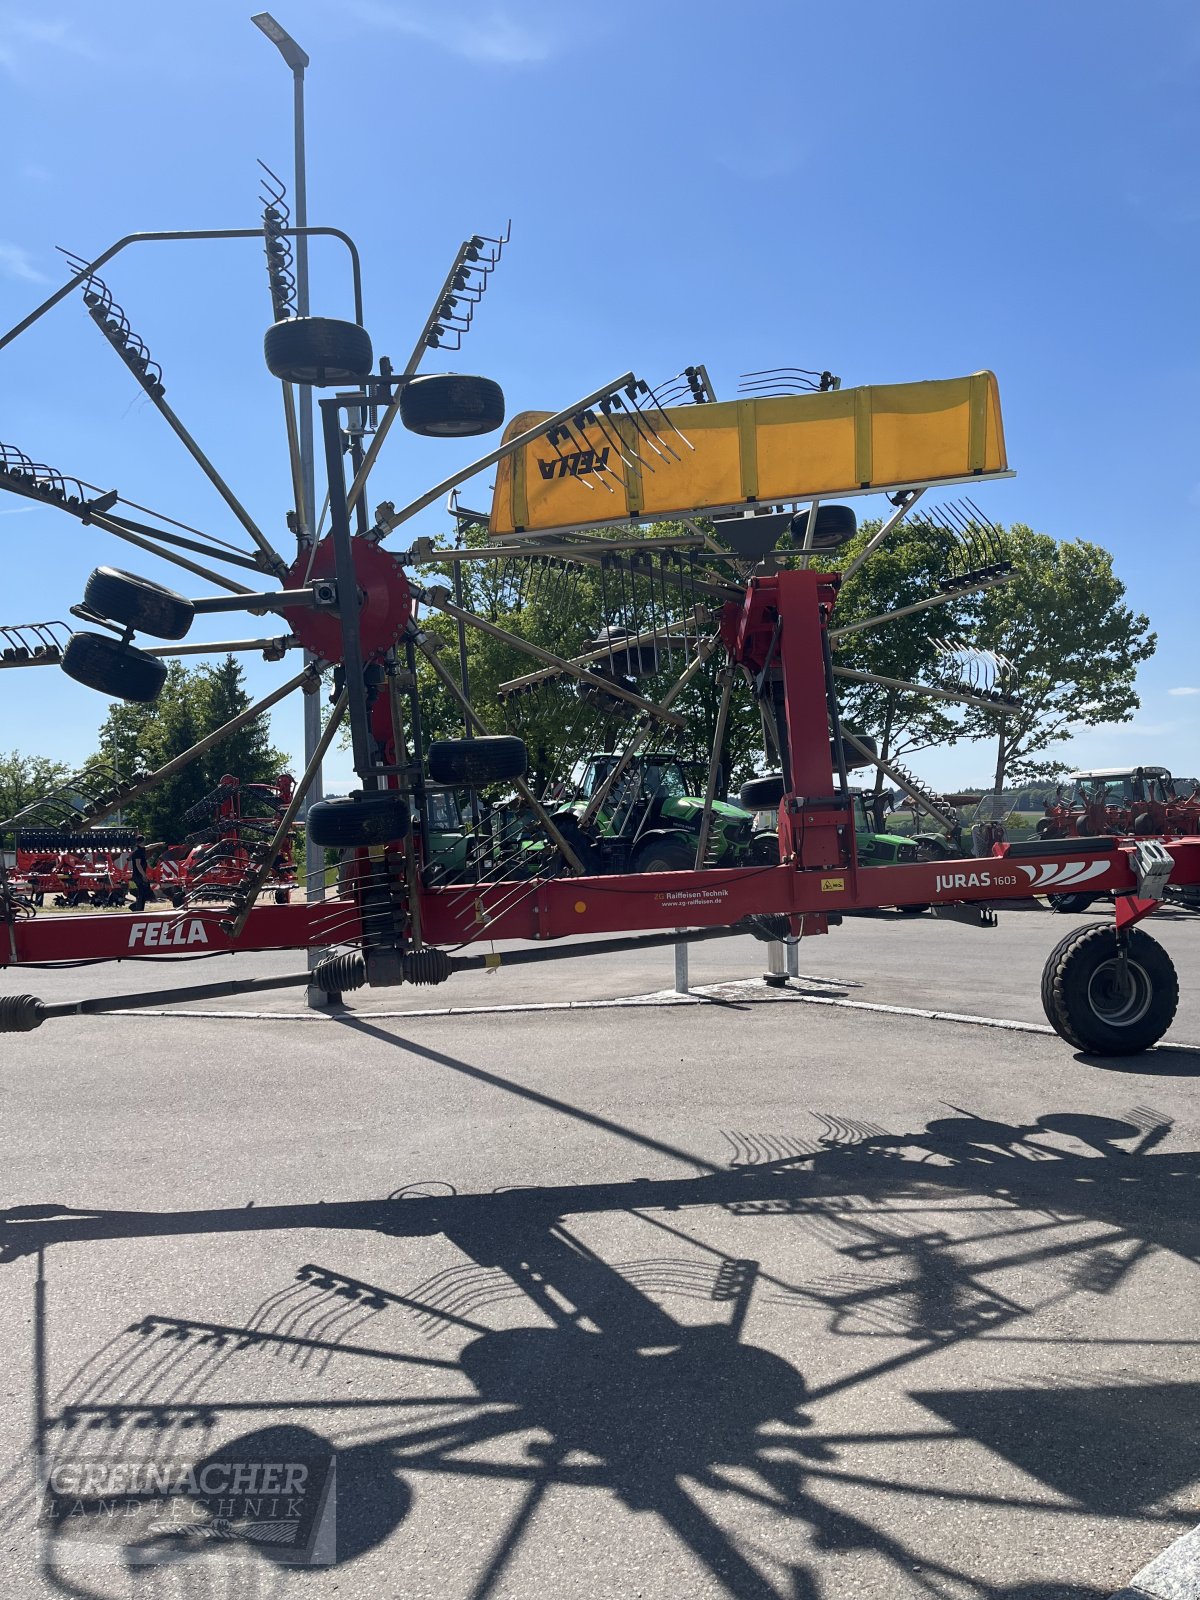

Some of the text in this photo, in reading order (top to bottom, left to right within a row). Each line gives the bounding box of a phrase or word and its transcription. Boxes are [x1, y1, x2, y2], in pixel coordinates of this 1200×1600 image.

[537, 447, 610, 480] FELLA
[935, 872, 1017, 893] JURAS 1603
[661, 898, 722, 907] www.zg-raiffeisen.de
[666, 891, 701, 900] Raiffeisen
[702, 889, 729, 898] Technik
[128, 920, 208, 947] FELLA
